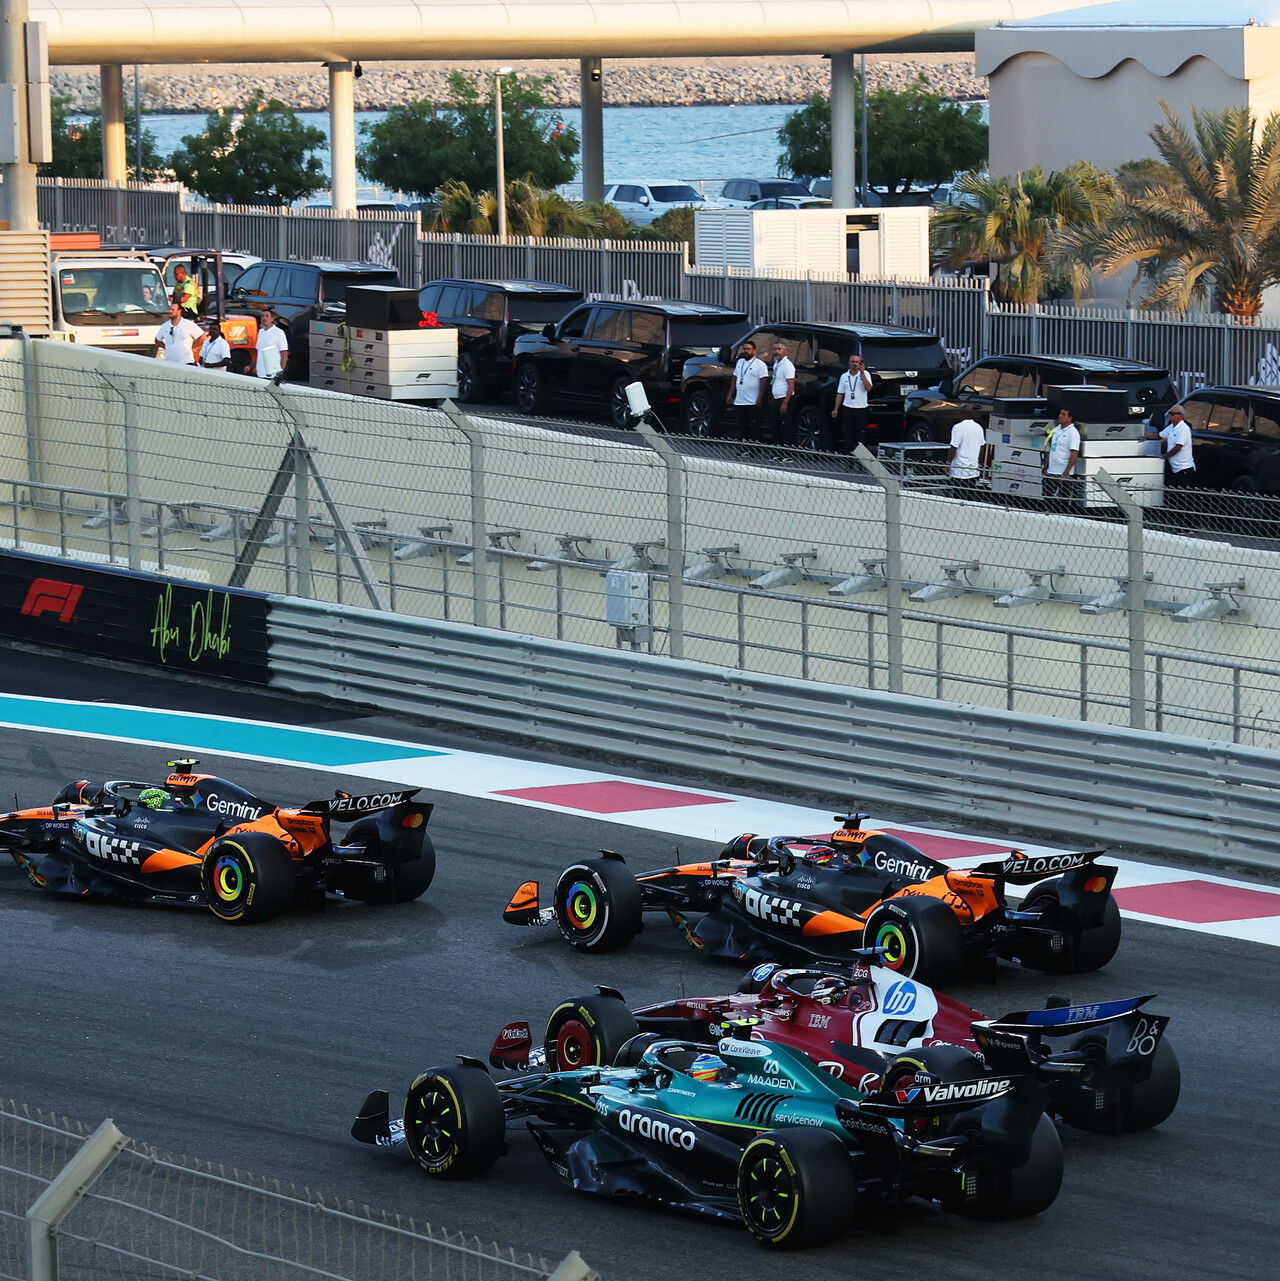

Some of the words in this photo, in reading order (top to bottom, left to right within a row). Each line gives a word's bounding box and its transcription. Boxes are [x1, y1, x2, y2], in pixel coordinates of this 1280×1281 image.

[151, 583, 180, 663] Abu
[189, 588, 232, 663] Dhabi
[206, 793, 262, 821] Gemini
[328, 792, 404, 812] VELO.COM
[54, 822, 70, 830] WORLD
[86, 830, 141, 865] OKX
[874, 850, 934, 881] Gemini
[1002, 854, 1085, 874] VELO.COM
[745, 888, 802, 927] OKX
[853, 968, 868, 978] ZCG
[884, 981, 917, 1015] hp
[808, 1013, 832, 1029] IBM
[1066, 1004, 1100, 1023] IBM
[747, 1073, 797, 1090] MAADEN
[914, 1073, 931, 1084] arm
[923, 1079, 1011, 1102] Valvoline
[619, 1109, 697, 1151] aramco
[774, 1112, 824, 1128] servicenow
[839, 1118, 888, 1135] coinbase
